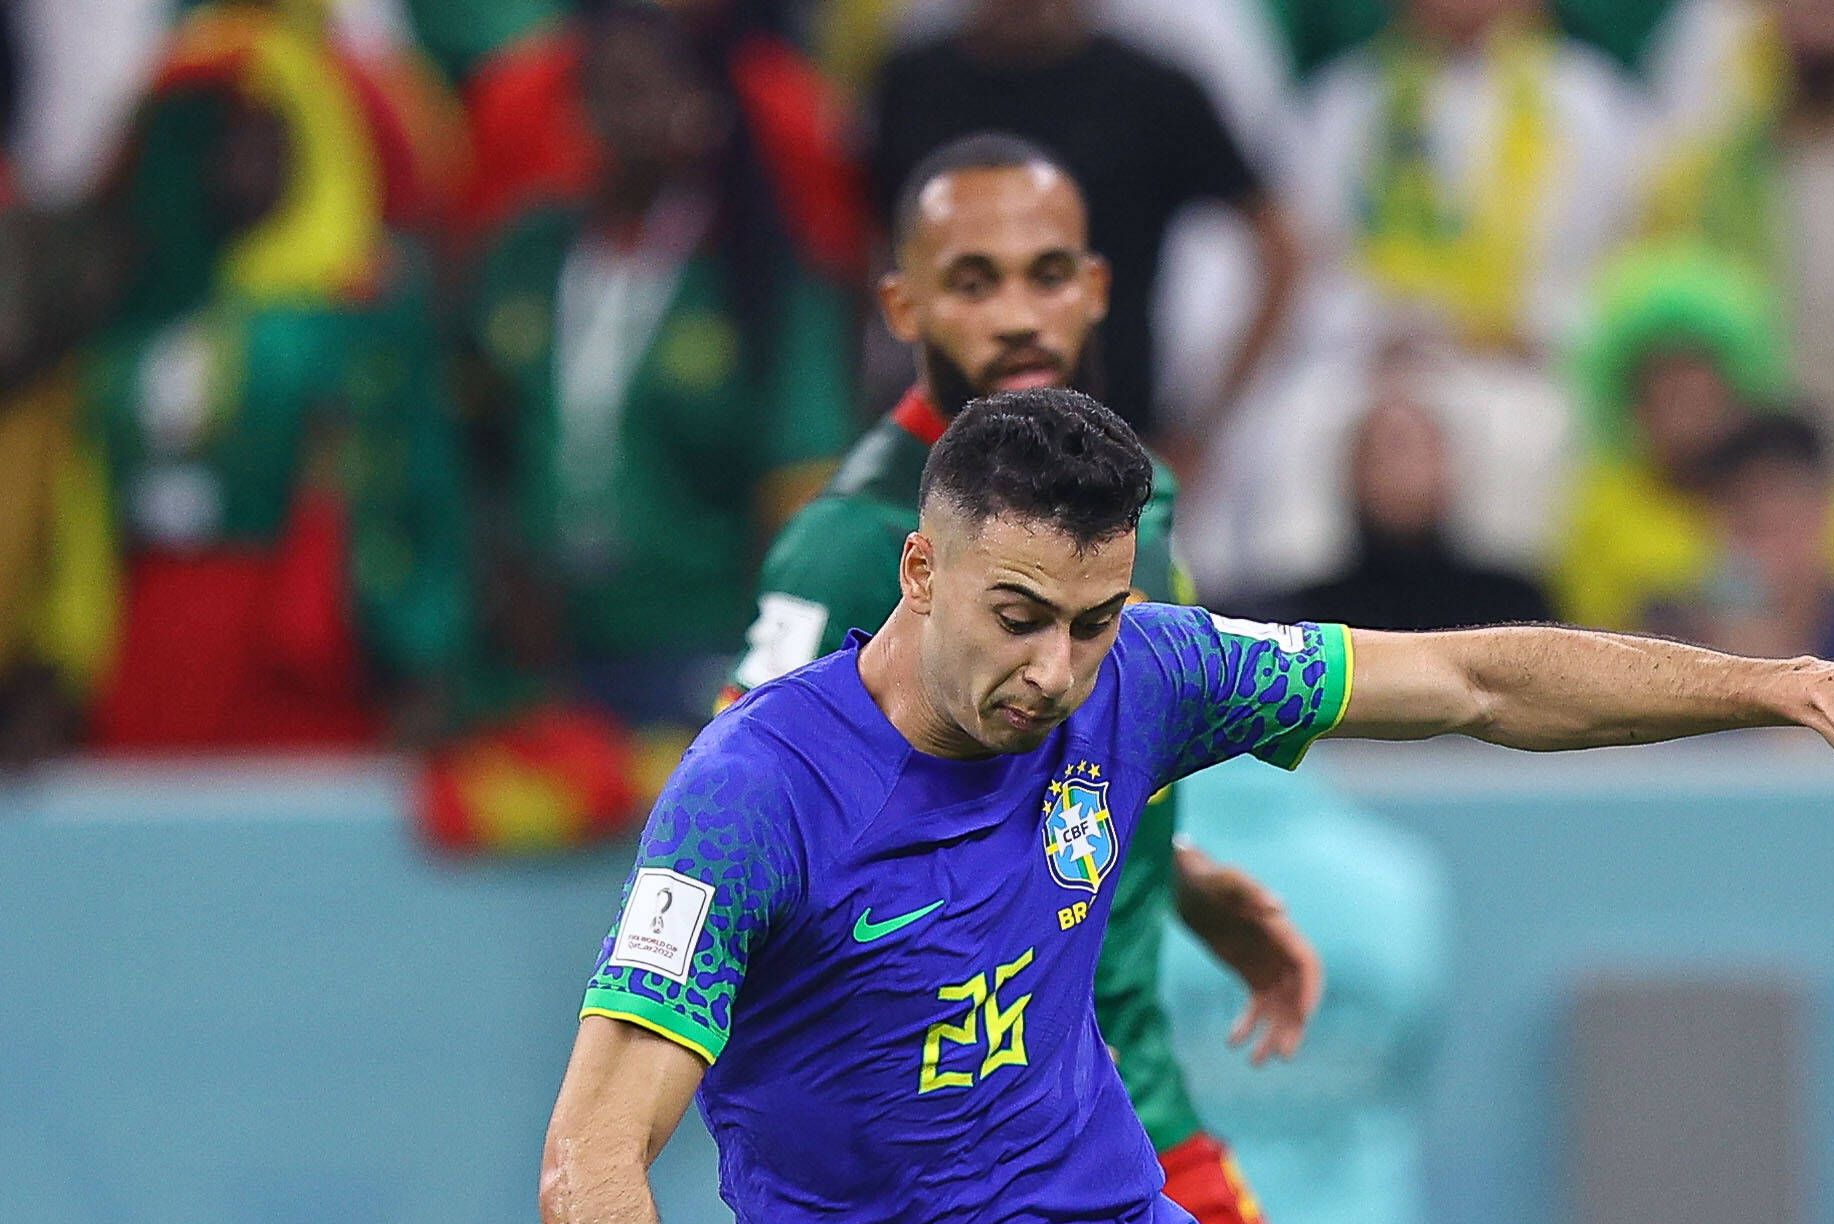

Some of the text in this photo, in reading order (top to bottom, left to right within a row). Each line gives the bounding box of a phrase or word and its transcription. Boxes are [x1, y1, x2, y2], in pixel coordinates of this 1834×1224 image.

[1062, 820, 1090, 844] CBF
[641, 935, 666, 948] WORLD
[917, 945, 1036, 1095] 26
